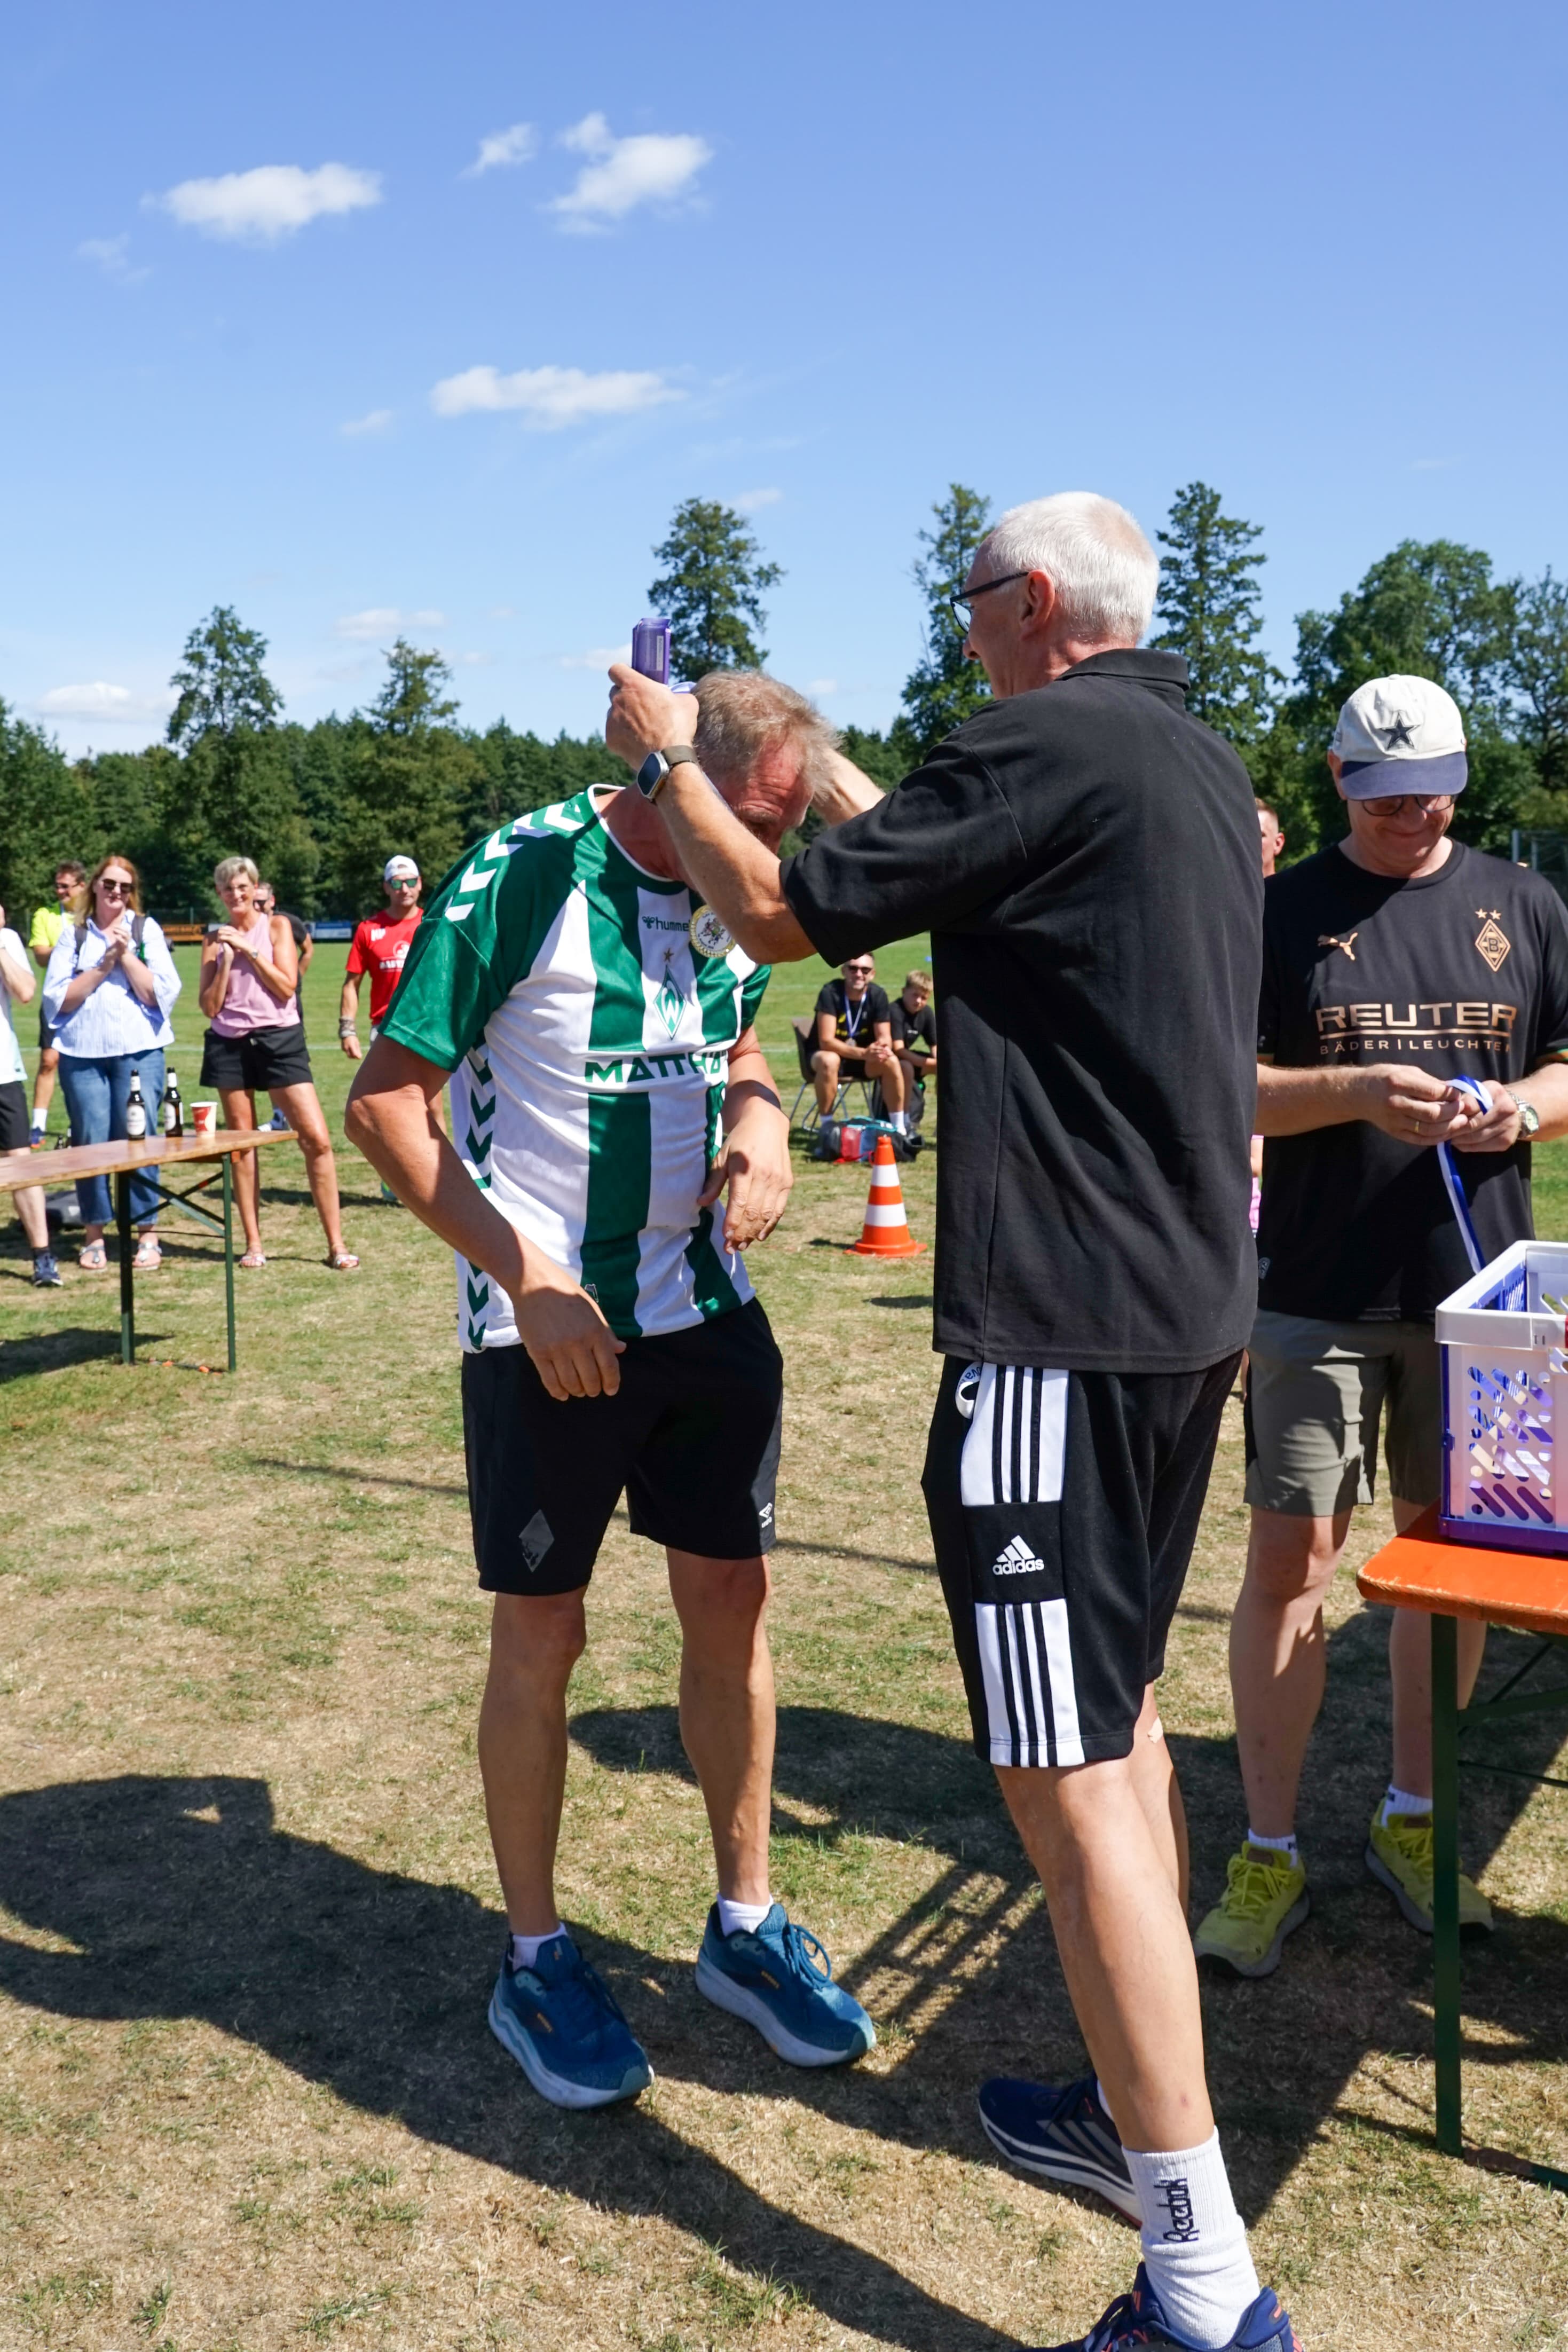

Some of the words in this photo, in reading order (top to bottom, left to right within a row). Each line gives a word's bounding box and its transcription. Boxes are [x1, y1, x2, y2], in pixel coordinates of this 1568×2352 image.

[656, 917, 690, 932] humme
[1488, 938, 1499, 952] B
[1315, 1002, 1517, 1032] REUTER
[1320, 1037, 1389, 1055] BÄDER
[993, 1559, 1044, 1575] adidas
[1153, 2178, 1200, 2242] Reebok
